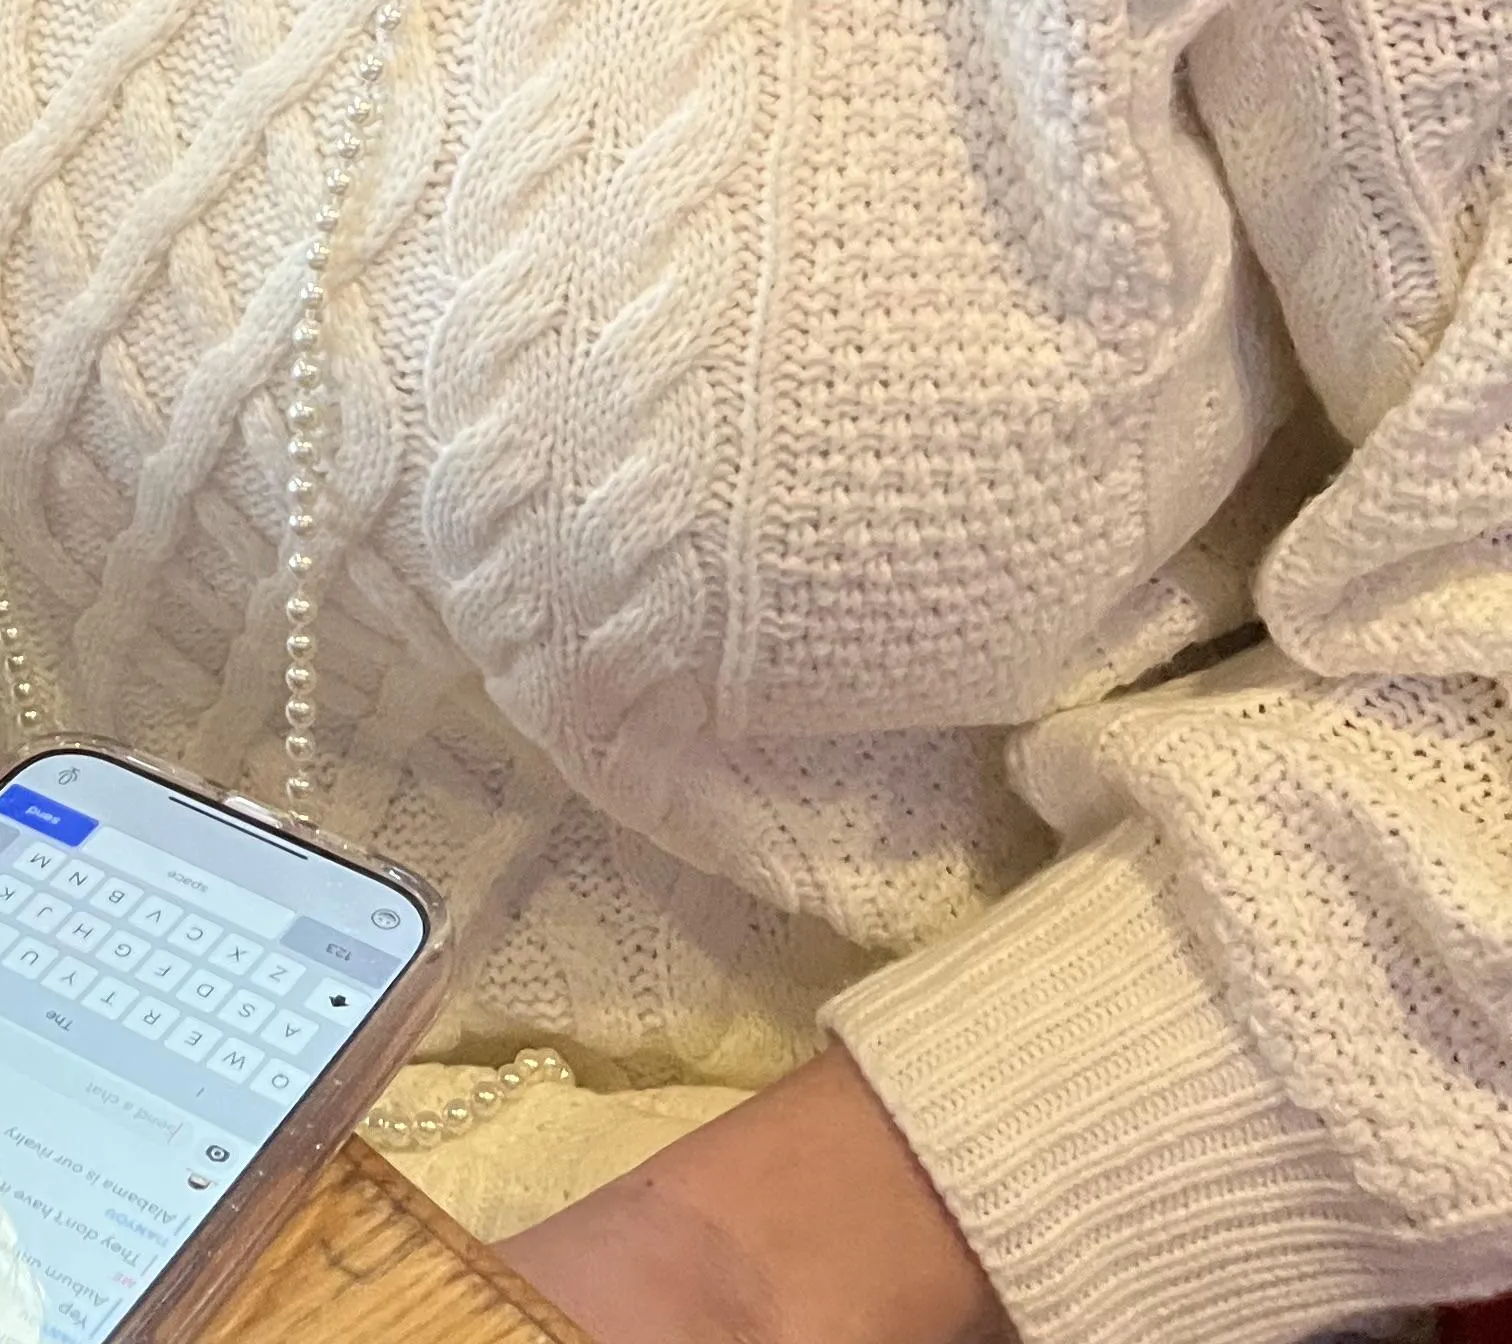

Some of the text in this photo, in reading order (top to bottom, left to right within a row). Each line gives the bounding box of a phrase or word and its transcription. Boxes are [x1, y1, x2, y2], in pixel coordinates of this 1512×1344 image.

[24, 805, 62, 826] send
[167, 869, 209, 894] space
[326, 942, 353, 962] 123
[45, 1010, 75, 1032] The
[86, 1081, 121, 1105] chat
[4, 1126, 177, 1226] Alabama is our rivalry
[13, 1189, 55, 1219] have
[52, 1211, 99, 1241] don't
[100, 1236, 140, 1268] They
[44, 1261, 109, 1307] Auburn
[58, 1301, 88, 1329] Yep
